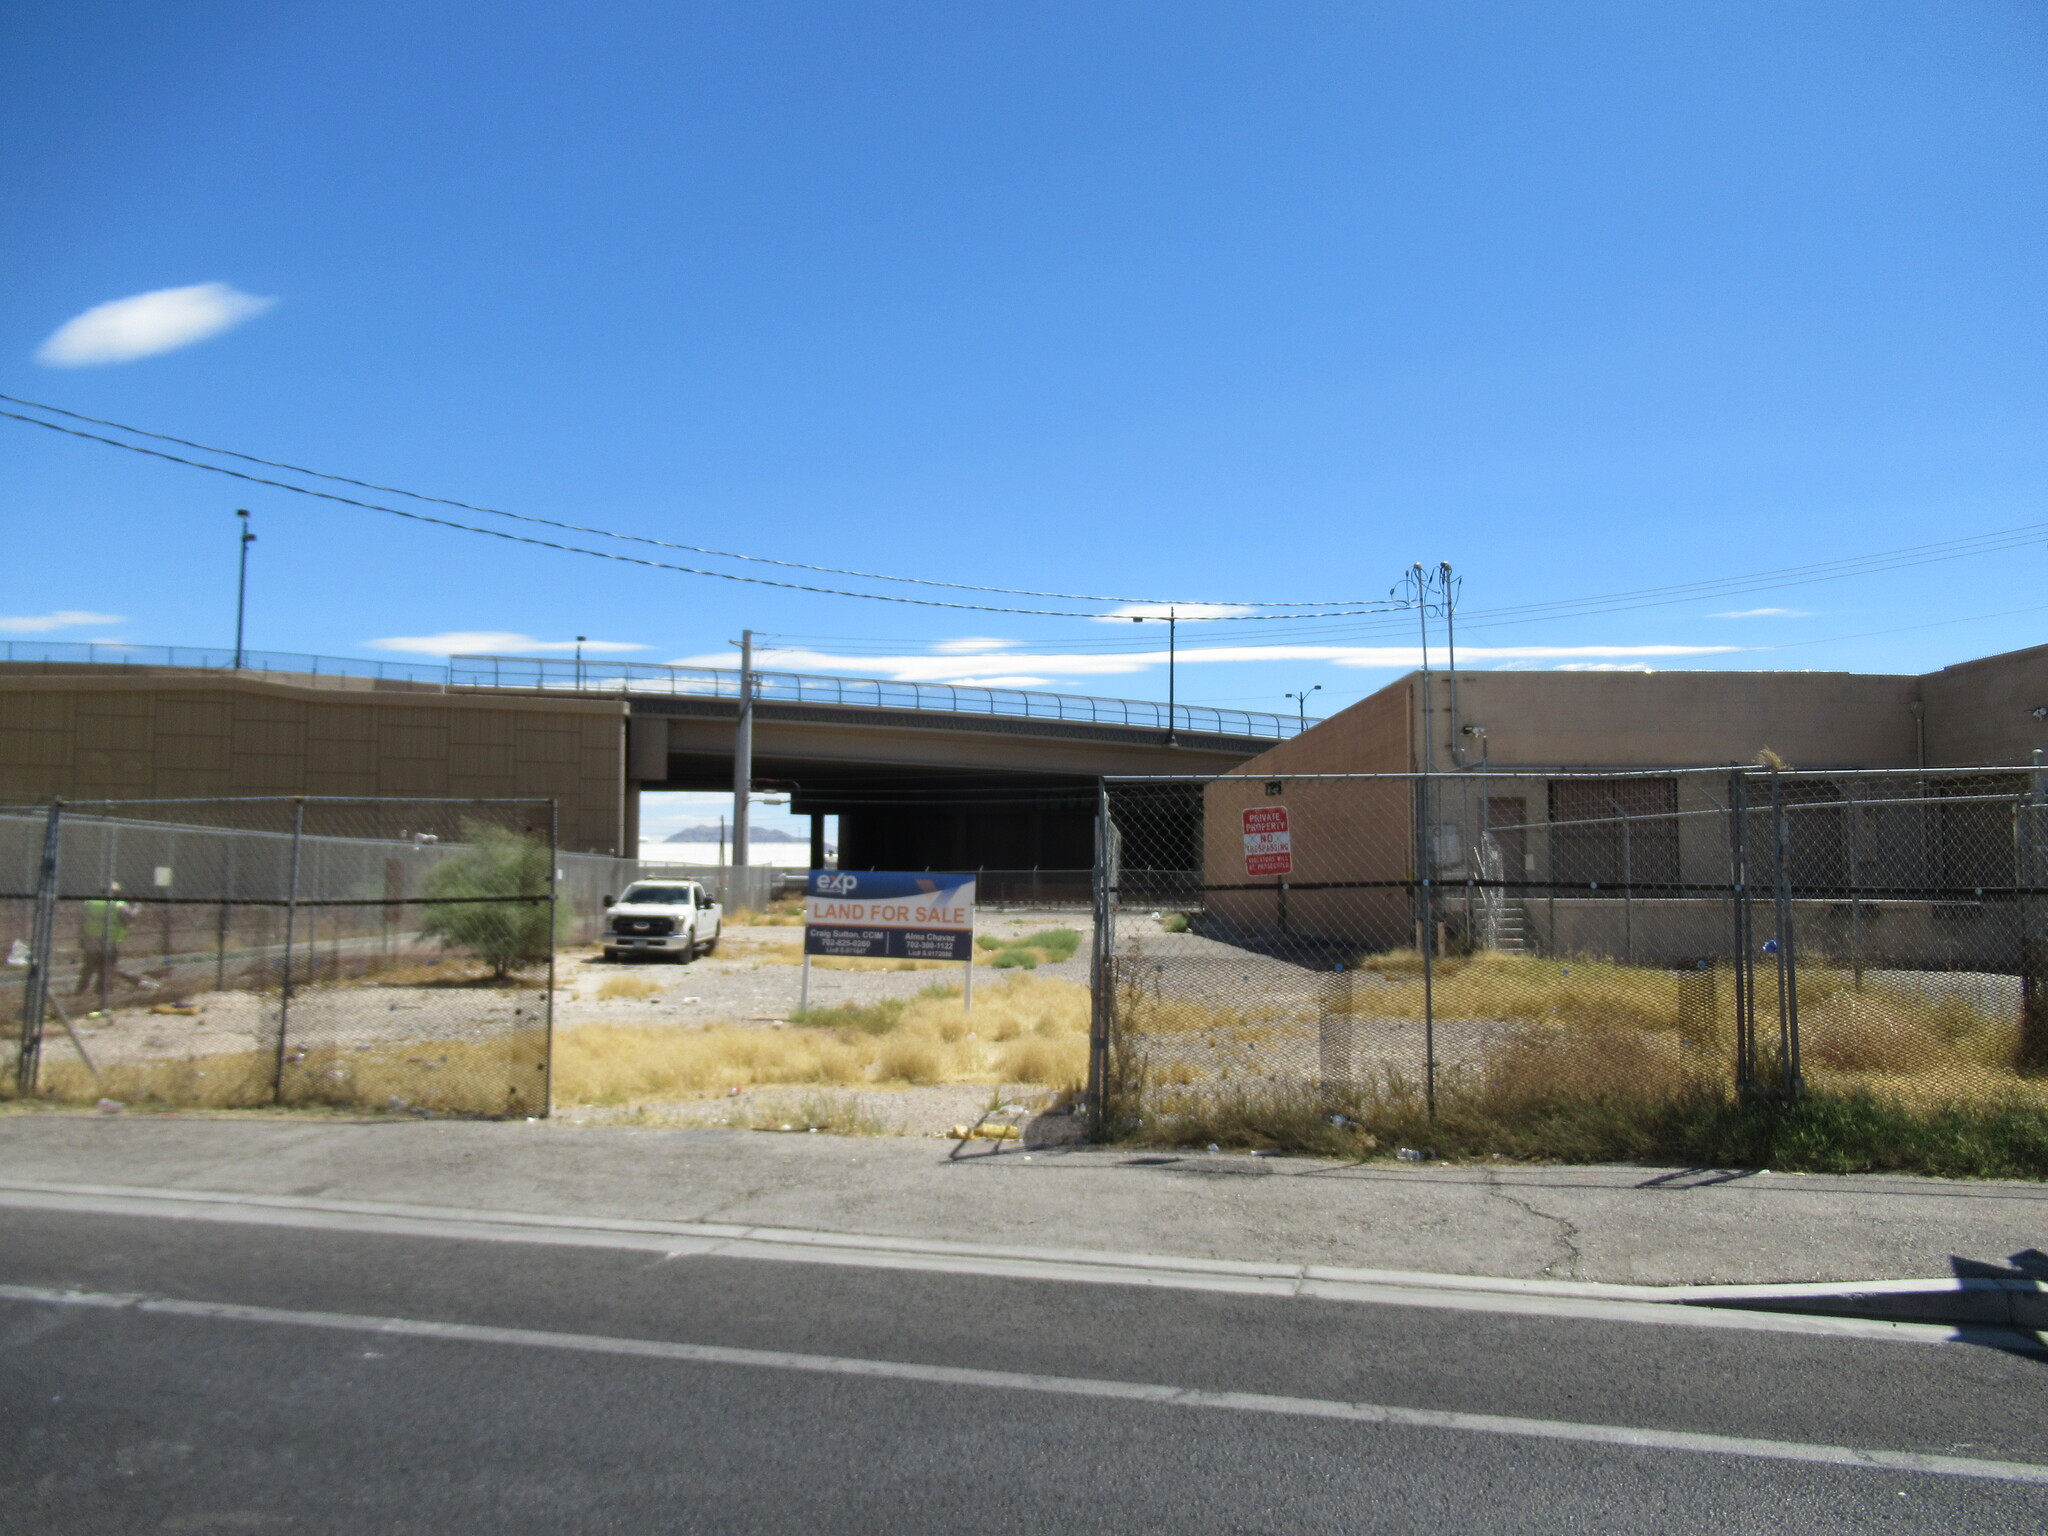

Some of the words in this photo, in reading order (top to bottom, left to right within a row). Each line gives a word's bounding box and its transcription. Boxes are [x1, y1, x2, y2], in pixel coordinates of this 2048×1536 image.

[1249, 813, 1280, 822] PRIVATE
[1246, 821, 1285, 832] PROPERTY
[1260, 833, 1273, 843] NO
[1246, 843, 1289, 853] TRESPASSING
[816, 872, 857, 895] exp
[813, 903, 865, 921] LAND
[870, 905, 909, 921] FOR
[915, 906, 965, 924] SALE
[810, 929, 831, 939] Craig
[862, 930, 884, 939] CCIM
[904, 932, 925, 941] Alma
[926, 932, 955, 942] Chavez
